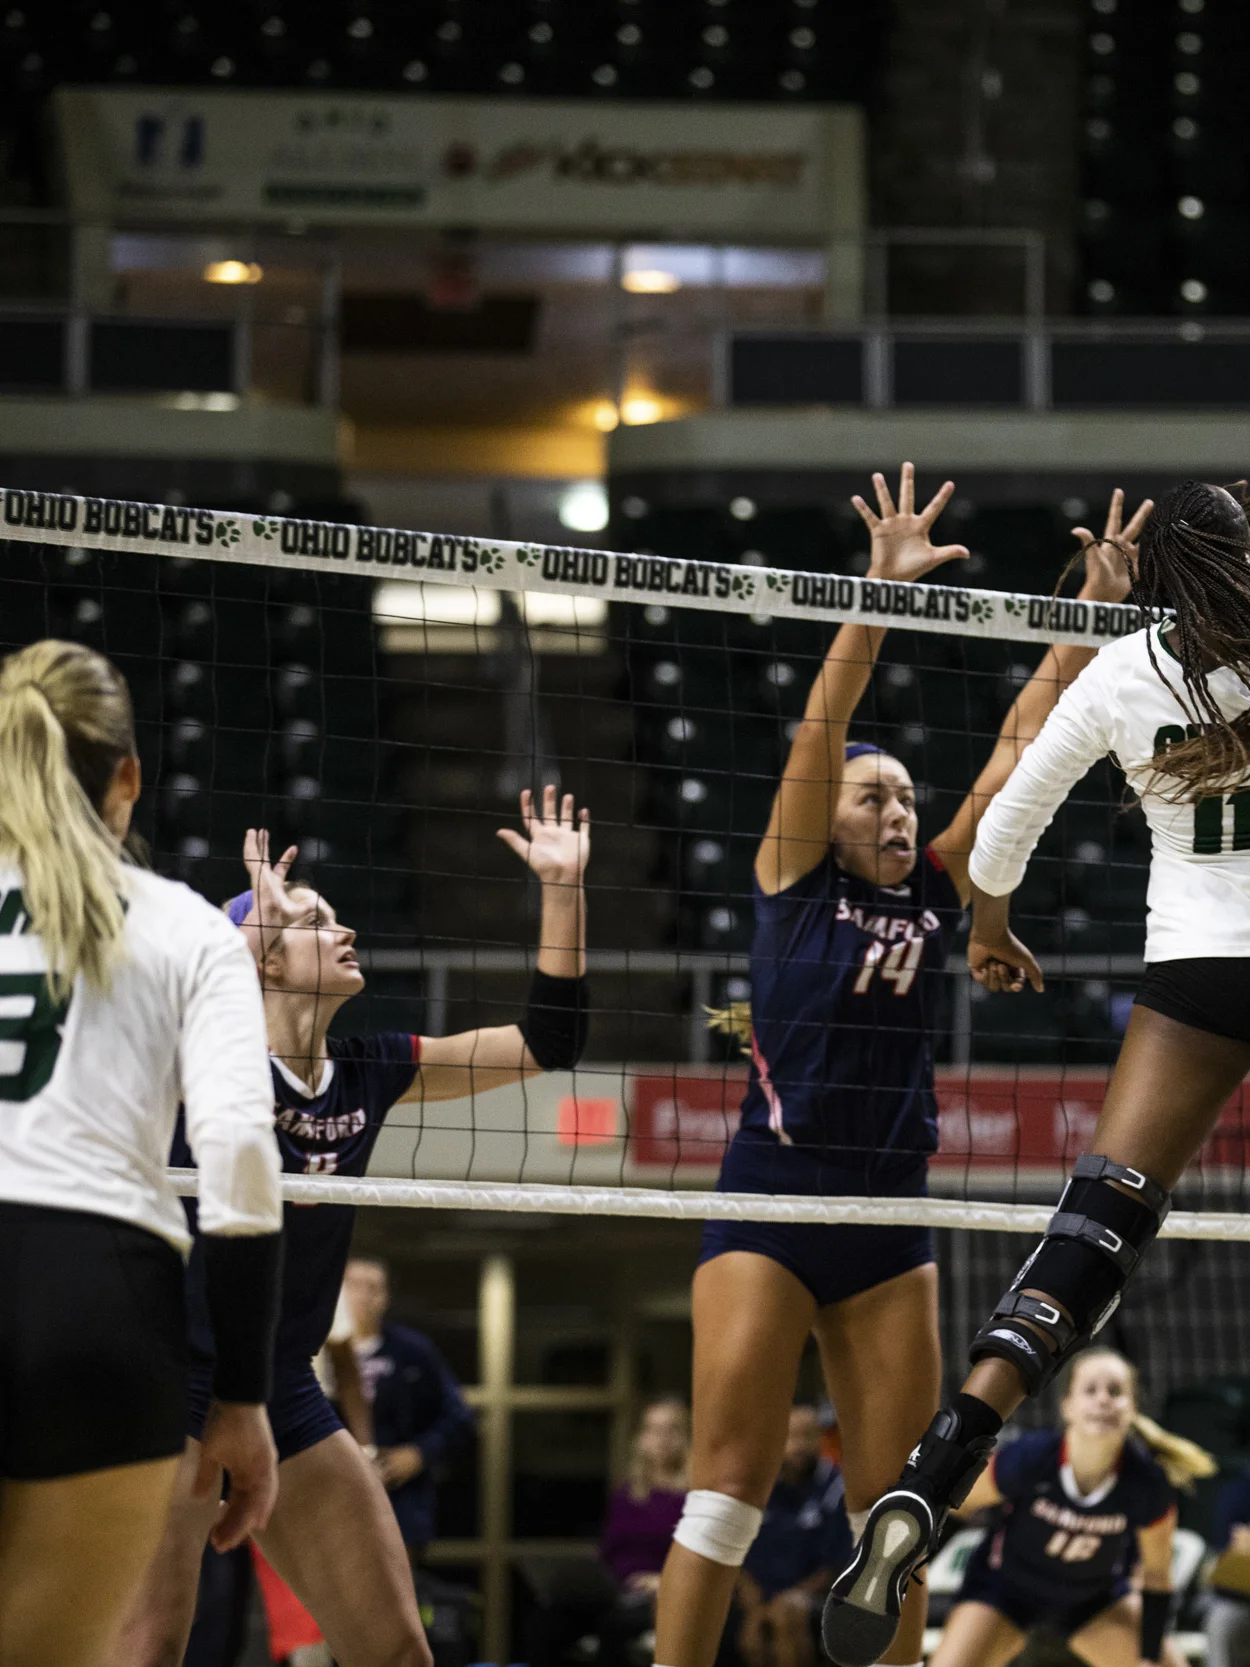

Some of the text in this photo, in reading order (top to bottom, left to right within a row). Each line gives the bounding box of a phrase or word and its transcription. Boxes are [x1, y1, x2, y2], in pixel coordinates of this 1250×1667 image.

[4, 491, 214, 546] OHIO BOBCATS
[281, 519, 479, 573] OHIO BOBCATS
[543, 547, 732, 599] OHIO BOBCATS
[792, 578, 971, 623] OHIO BOBCATS
[1029, 599, 1086, 634] OHIO
[852, 937, 924, 996] 14
[275, 1105, 367, 1142] AMFORD
